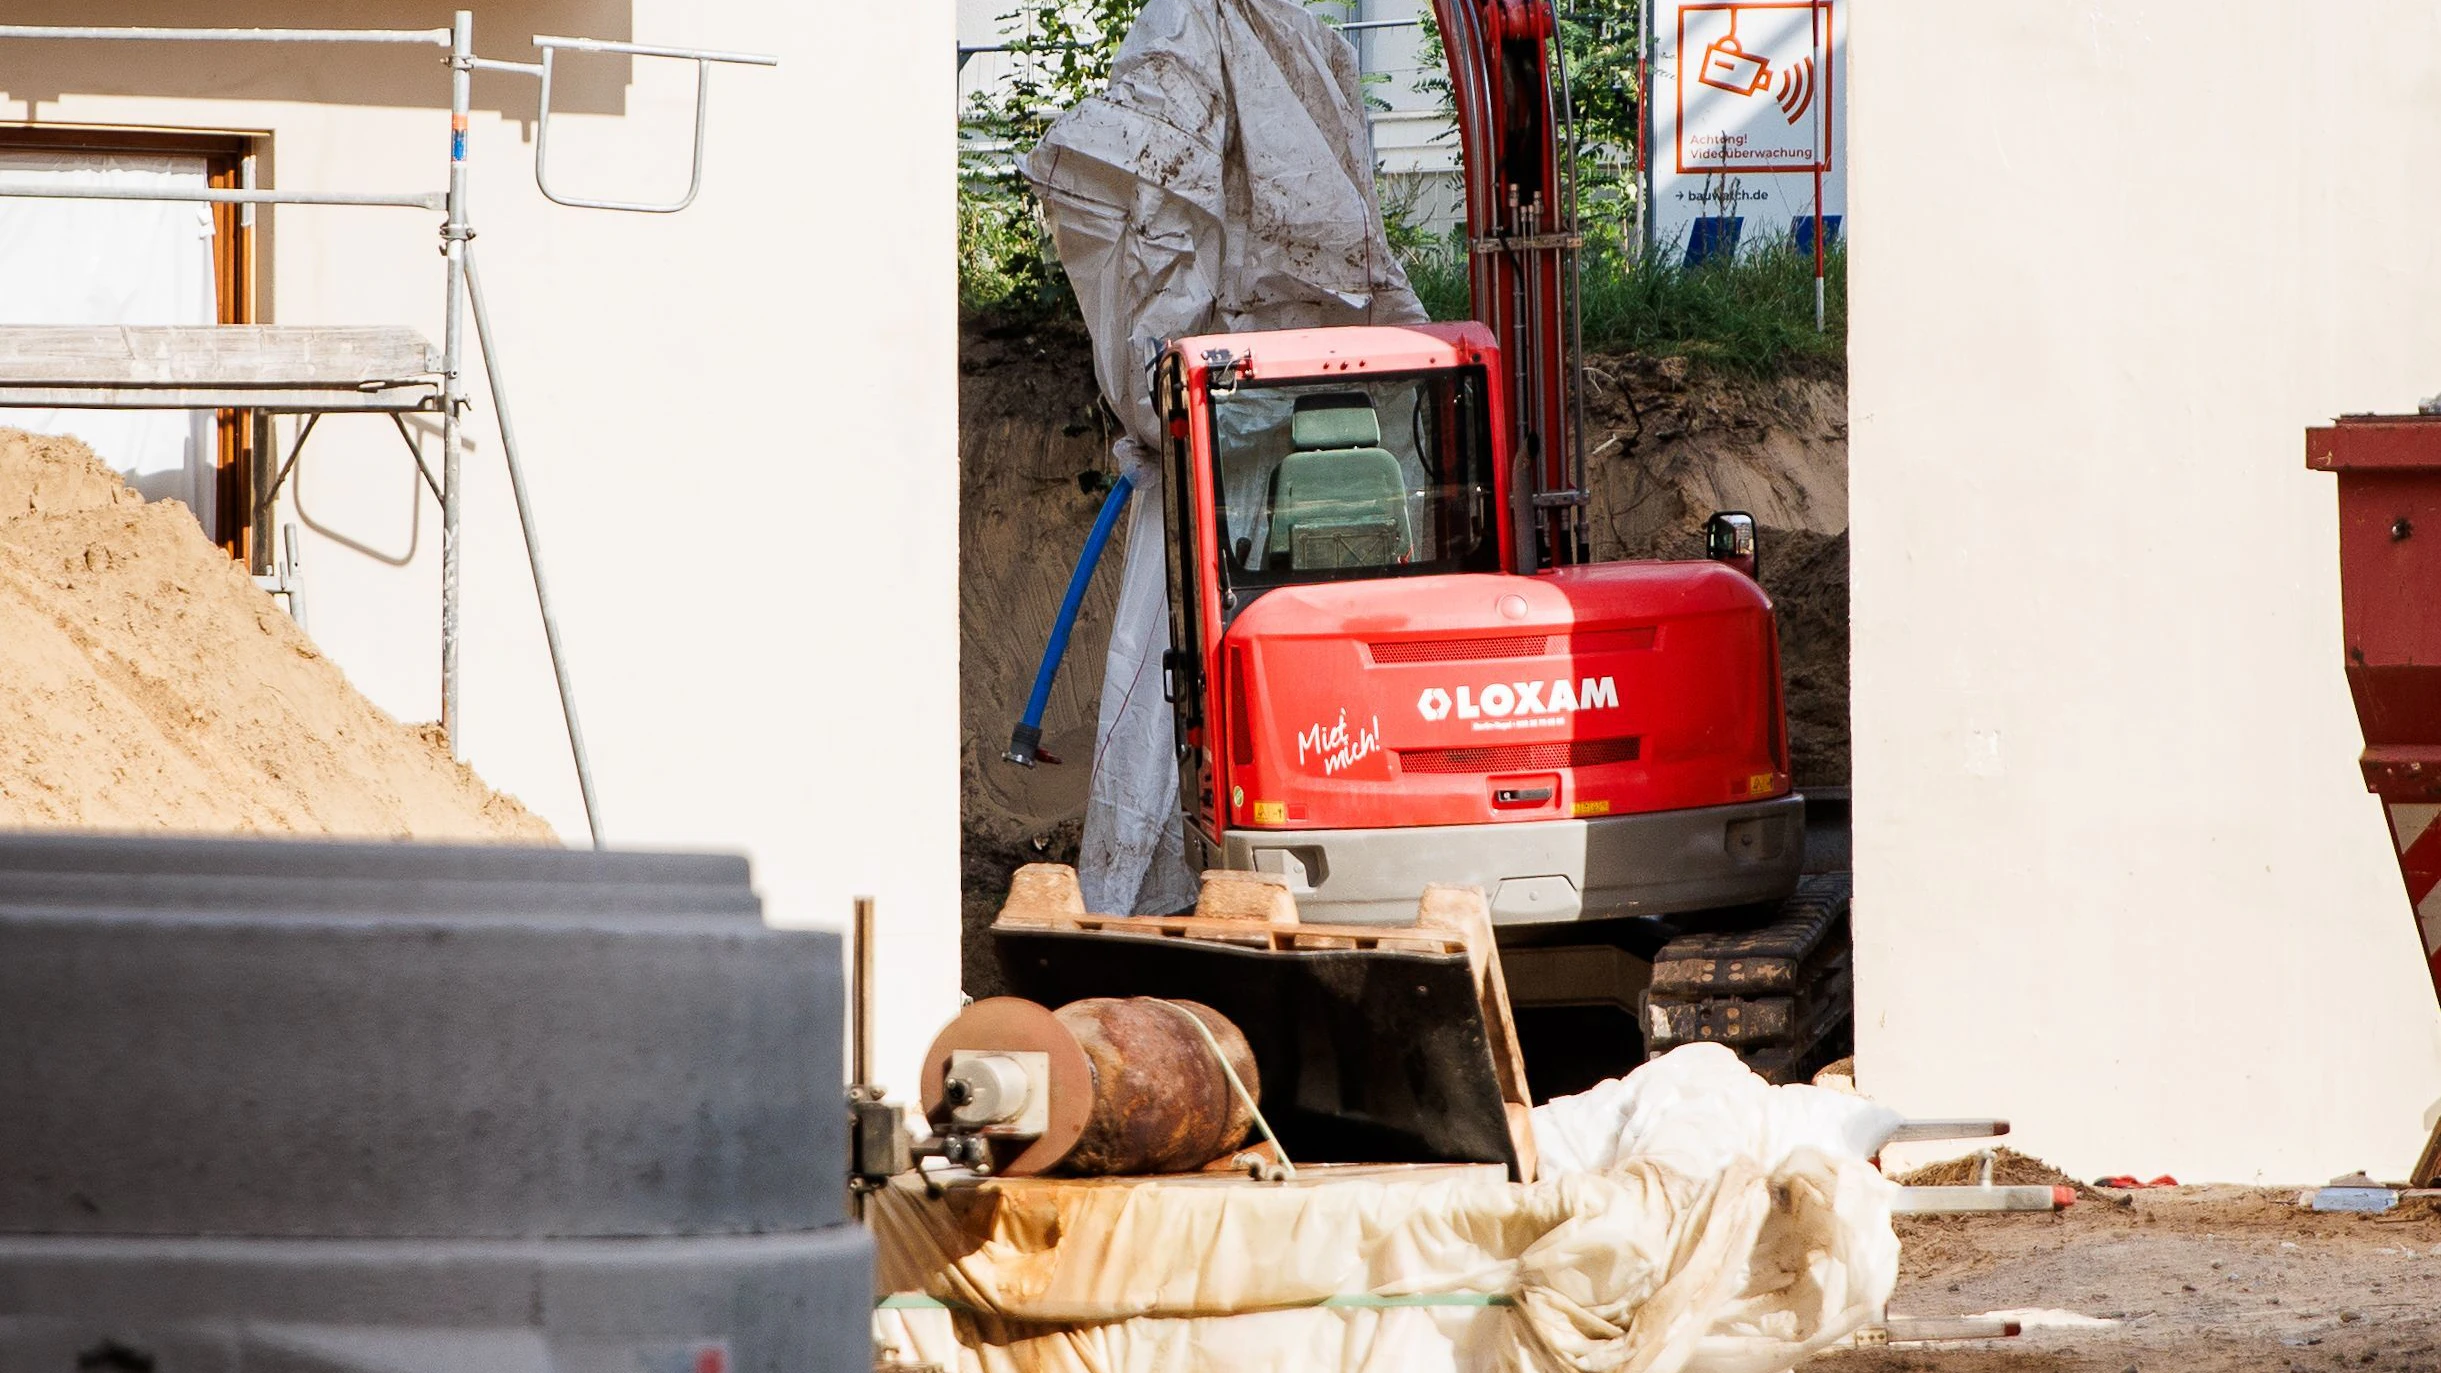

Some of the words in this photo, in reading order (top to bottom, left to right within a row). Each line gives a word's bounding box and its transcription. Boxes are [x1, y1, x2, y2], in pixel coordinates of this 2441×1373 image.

[1690, 133, 1748, 147] Achtung!
[1690, 147, 1813, 160] Videoüberwachung
[1456, 676, 1620, 720] LOXAM
[1324, 714, 1381, 776] mich!
